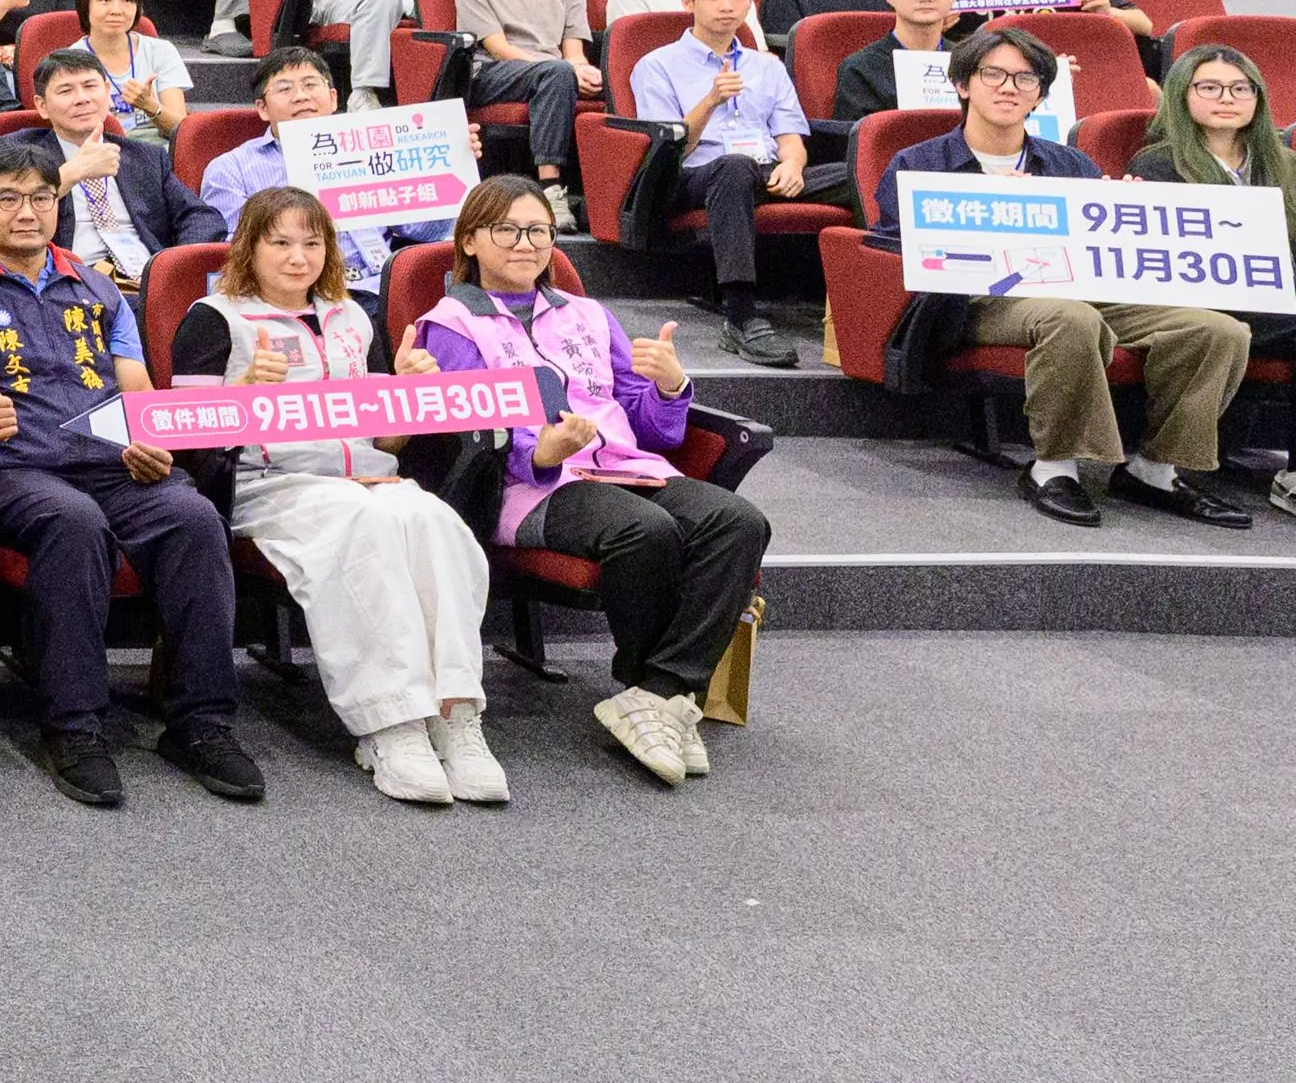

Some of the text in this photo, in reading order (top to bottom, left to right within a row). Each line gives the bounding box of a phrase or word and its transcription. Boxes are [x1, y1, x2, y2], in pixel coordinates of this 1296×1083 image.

[312, 124, 394, 156] 為桃園
[395, 124, 409, 134] DO
[397, 130, 447, 145] RESEARCH
[313, 162, 333, 172] FOR
[316, 166, 367, 182] TAOYUAN
[368, 144, 451, 176] 做研究
[338, 182, 438, 213] 創新點子組
[921, 197, 1060, 229] 徵件期間
[1081, 202, 1243, 239] 9月1日~
[1086, 244, 1283, 290] 11月30日
[150, 406, 241, 433] 徵件期間
[251, 380, 531, 432] 9月1日~11月30日
